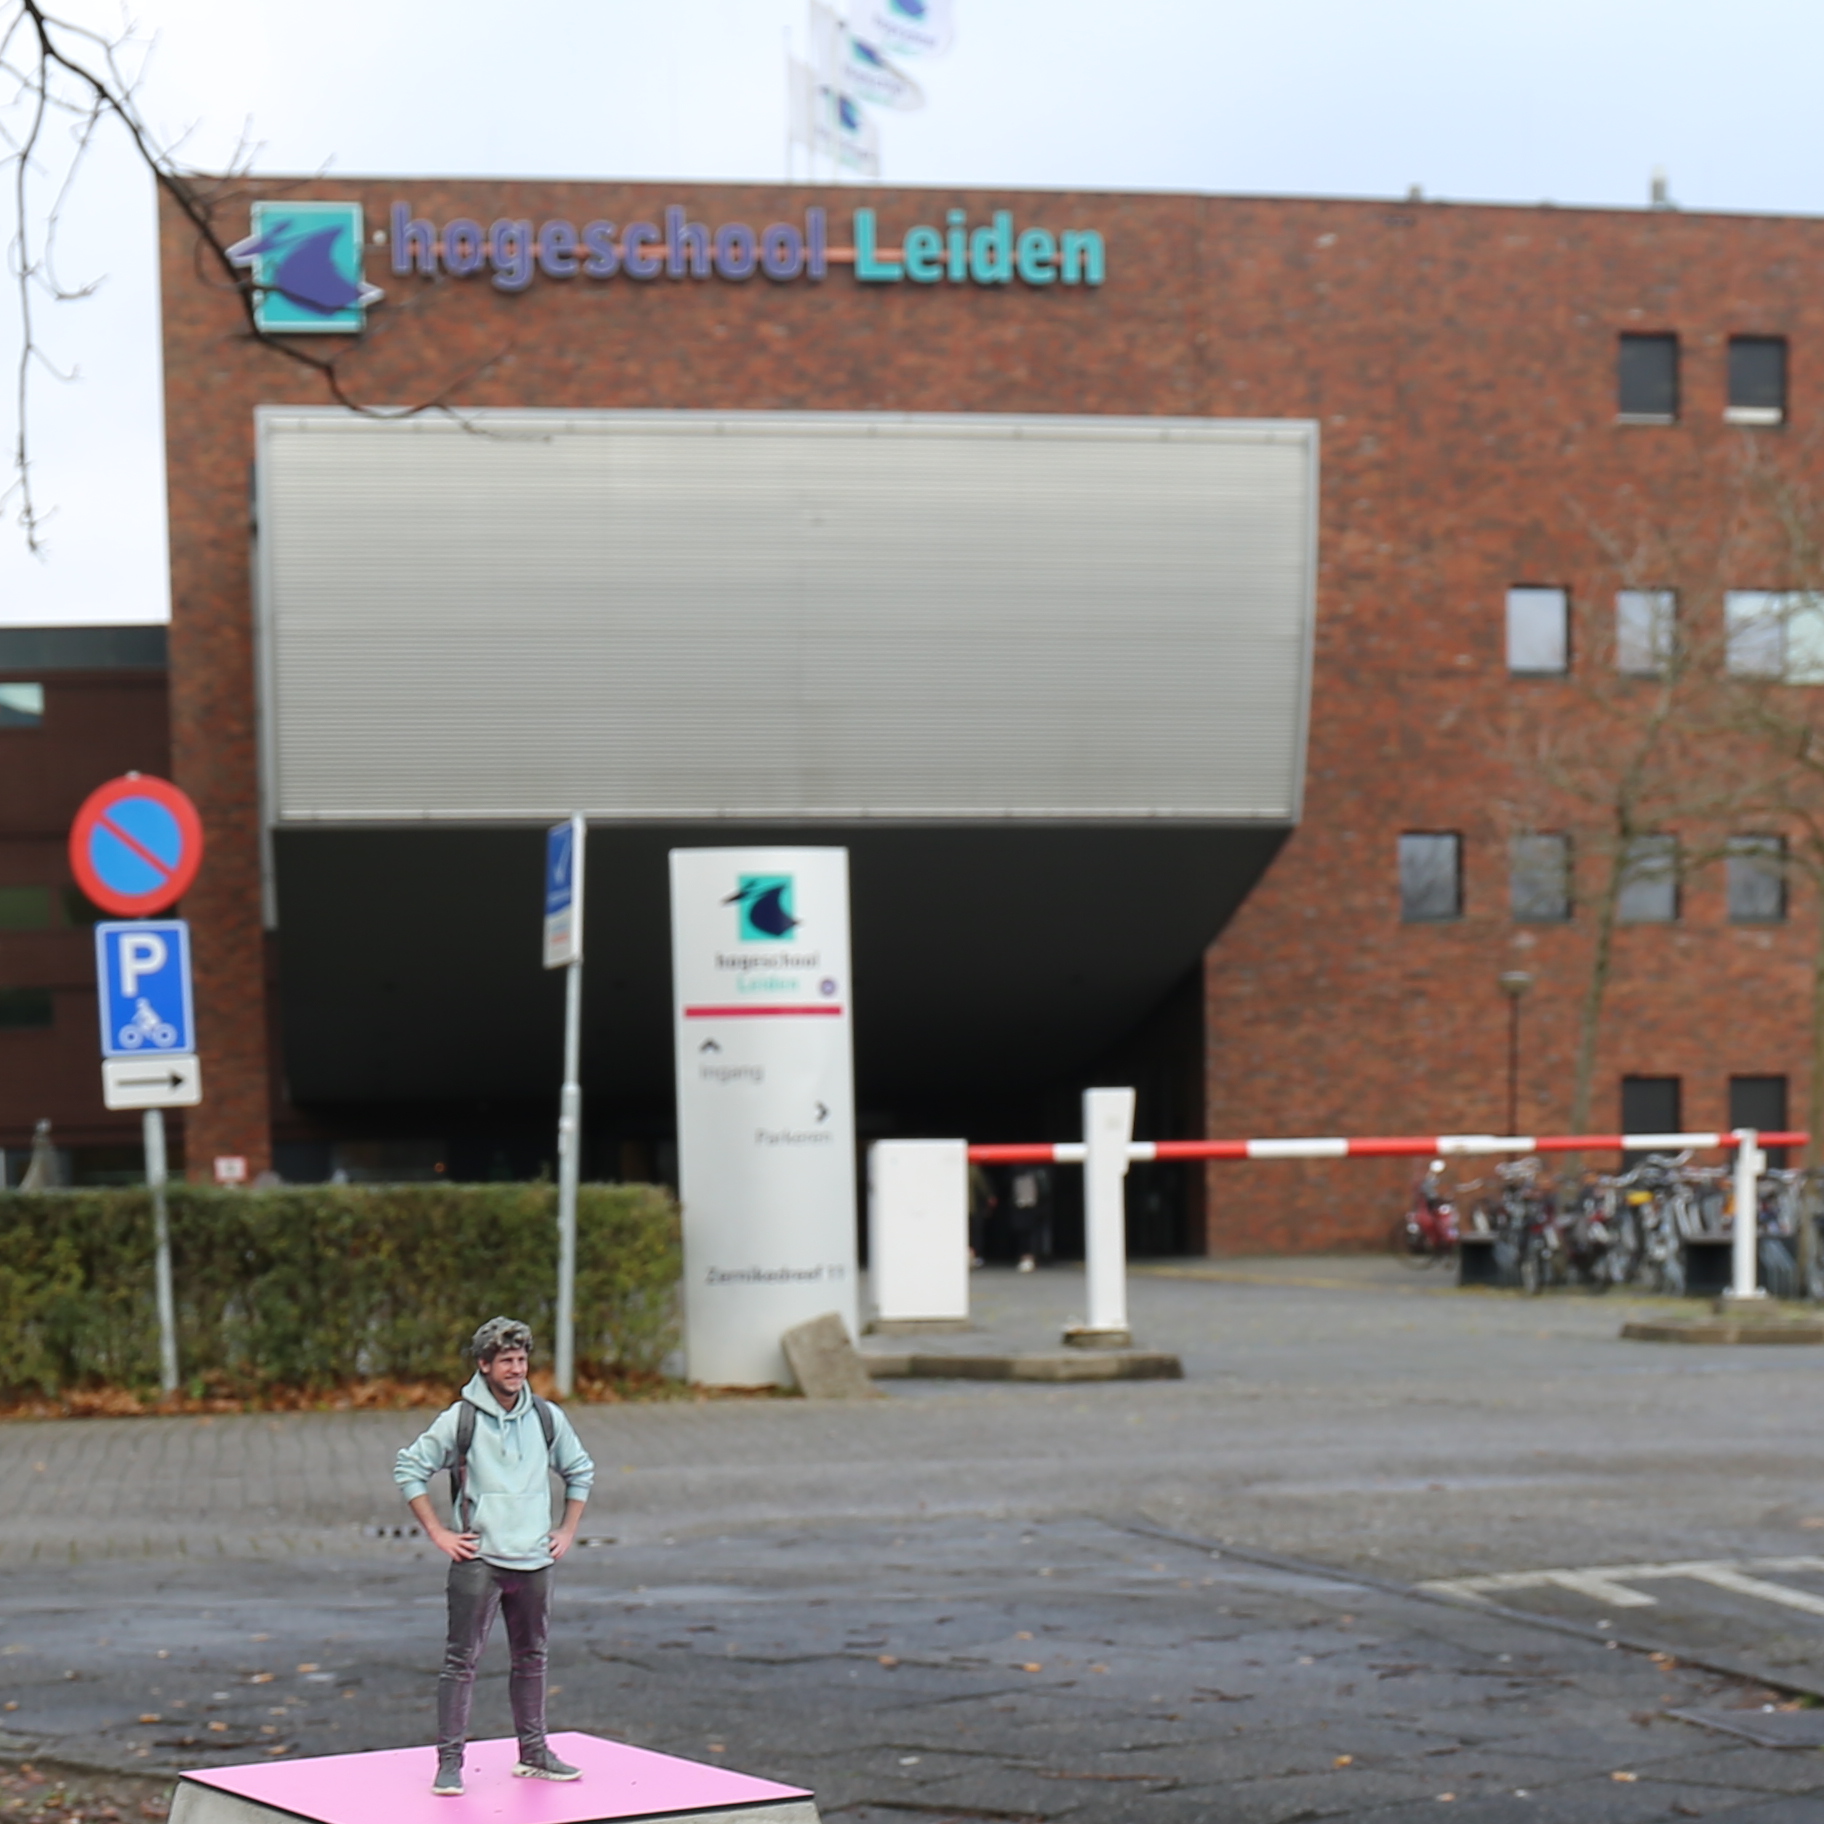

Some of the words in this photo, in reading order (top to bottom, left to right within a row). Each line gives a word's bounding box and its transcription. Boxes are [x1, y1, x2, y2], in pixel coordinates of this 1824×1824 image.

[389, 202, 826, 291] hogeschool
[853, 208, 1105, 286] Leiden
[119, 933, 167, 997] P
